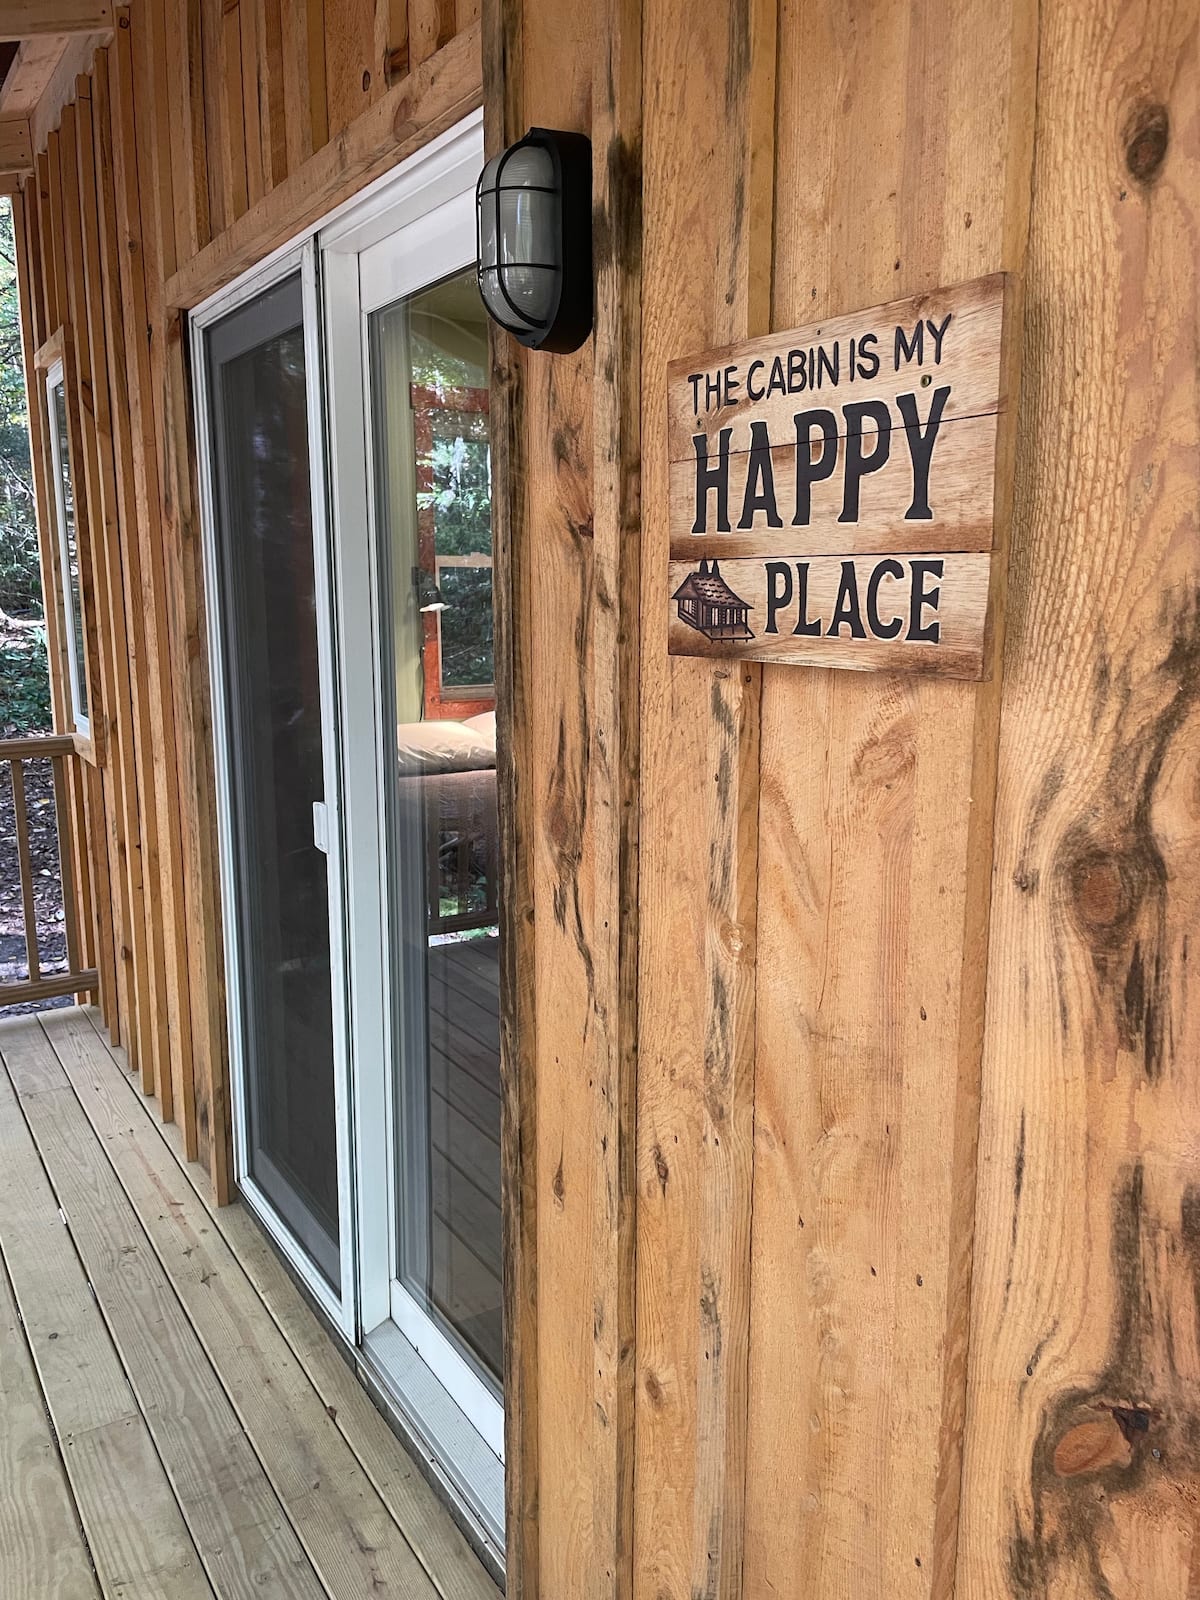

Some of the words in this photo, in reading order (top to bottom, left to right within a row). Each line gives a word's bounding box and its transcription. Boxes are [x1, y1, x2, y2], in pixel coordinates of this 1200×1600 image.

[688, 366, 739, 416] THE
[746, 341, 839, 402] CABIN
[850, 334, 880, 382] IS
[894, 313, 952, 372] MY
[691, 385, 952, 535] HAPPY
[765, 558, 944, 644] PLACE
